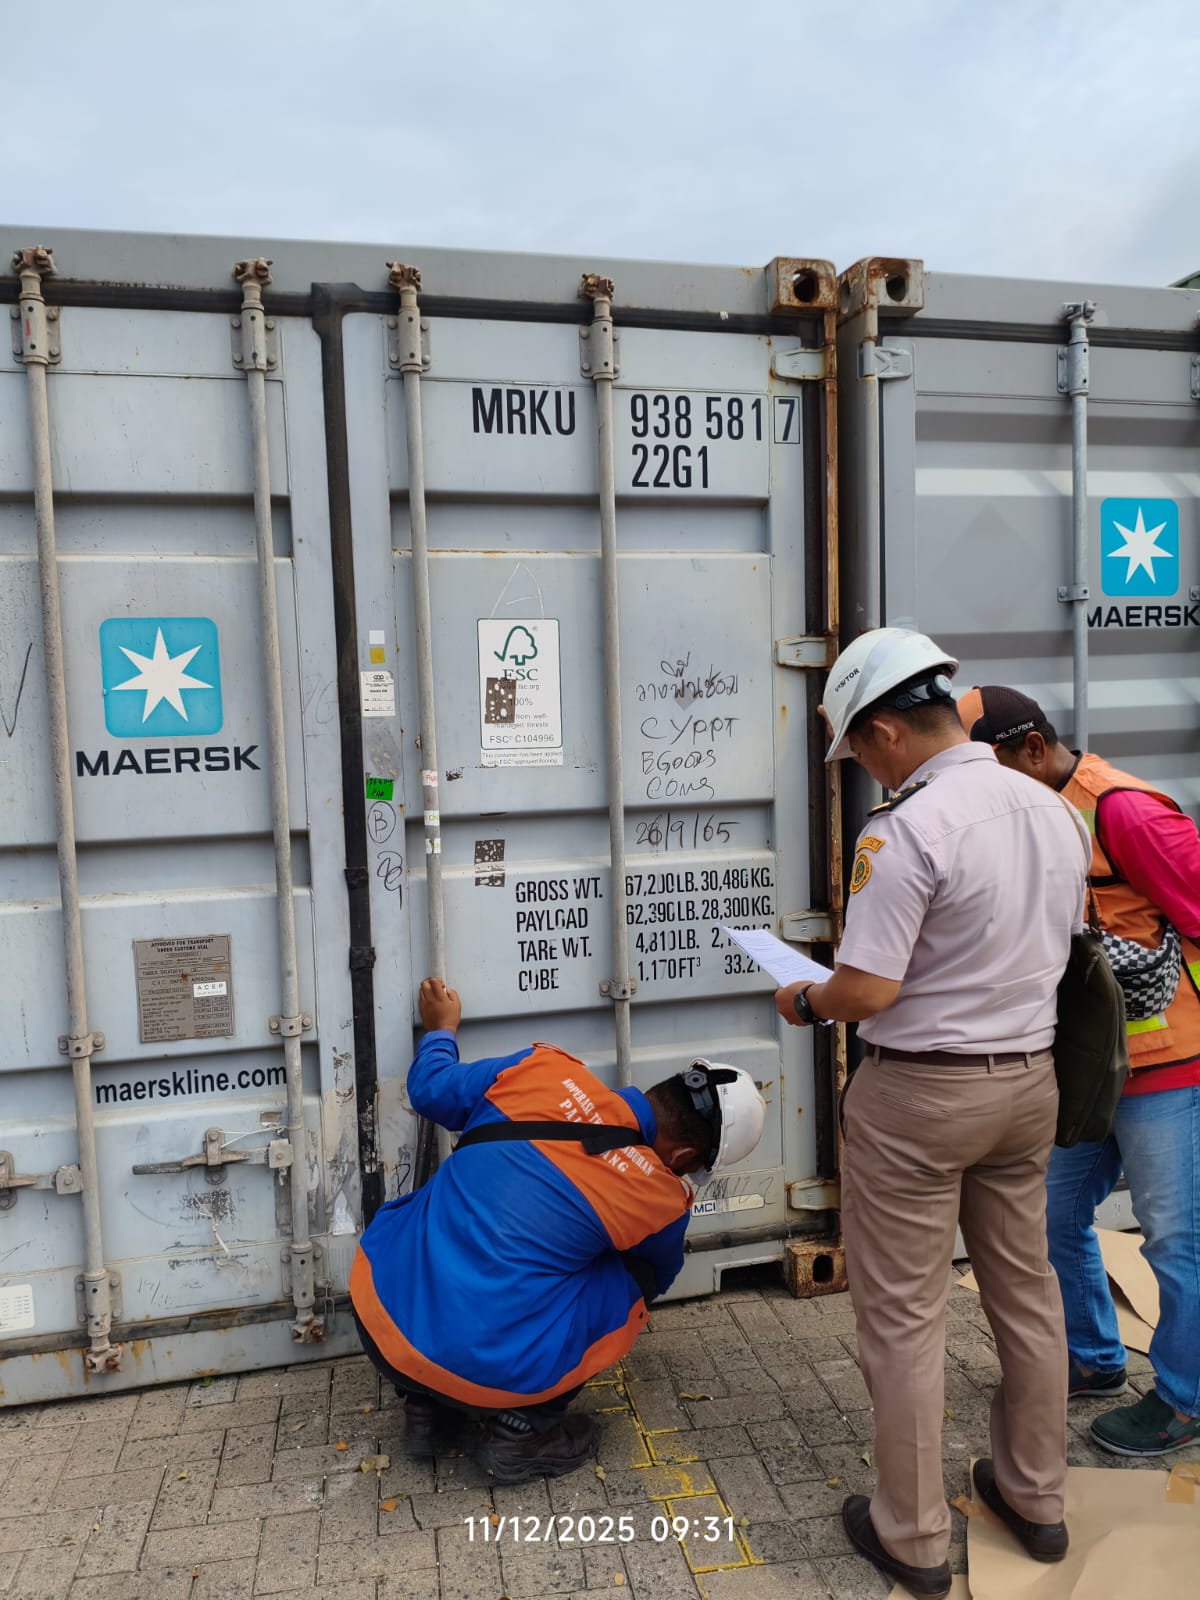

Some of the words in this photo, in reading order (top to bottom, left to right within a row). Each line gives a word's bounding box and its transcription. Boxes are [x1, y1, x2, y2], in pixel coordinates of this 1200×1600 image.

[471, 387, 576, 436] MRKU
[630, 394, 692, 439] 938
[705, 396, 762, 442] 581
[777, 399, 795, 442] 7
[631, 443, 709, 489] 22G1
[1087, 605, 1200, 628] MAERSK
[503, 668, 539, 681] FSC
[834, 668, 860, 693] VISITOR
[75, 744, 262, 777] MAERSK
[515, 879, 569, 903] GROSS
[573, 877, 603, 900] WT.
[516, 907, 588, 933] PAYLOAD
[702, 896, 749, 921] 28,300
[517, 938, 558, 962] TARE
[562, 935, 592, 958] WT.
[518, 967, 560, 992] CUBE
[96, 1065, 288, 1104] maerskline.com
[693, 1203, 716, 1214] MCI
